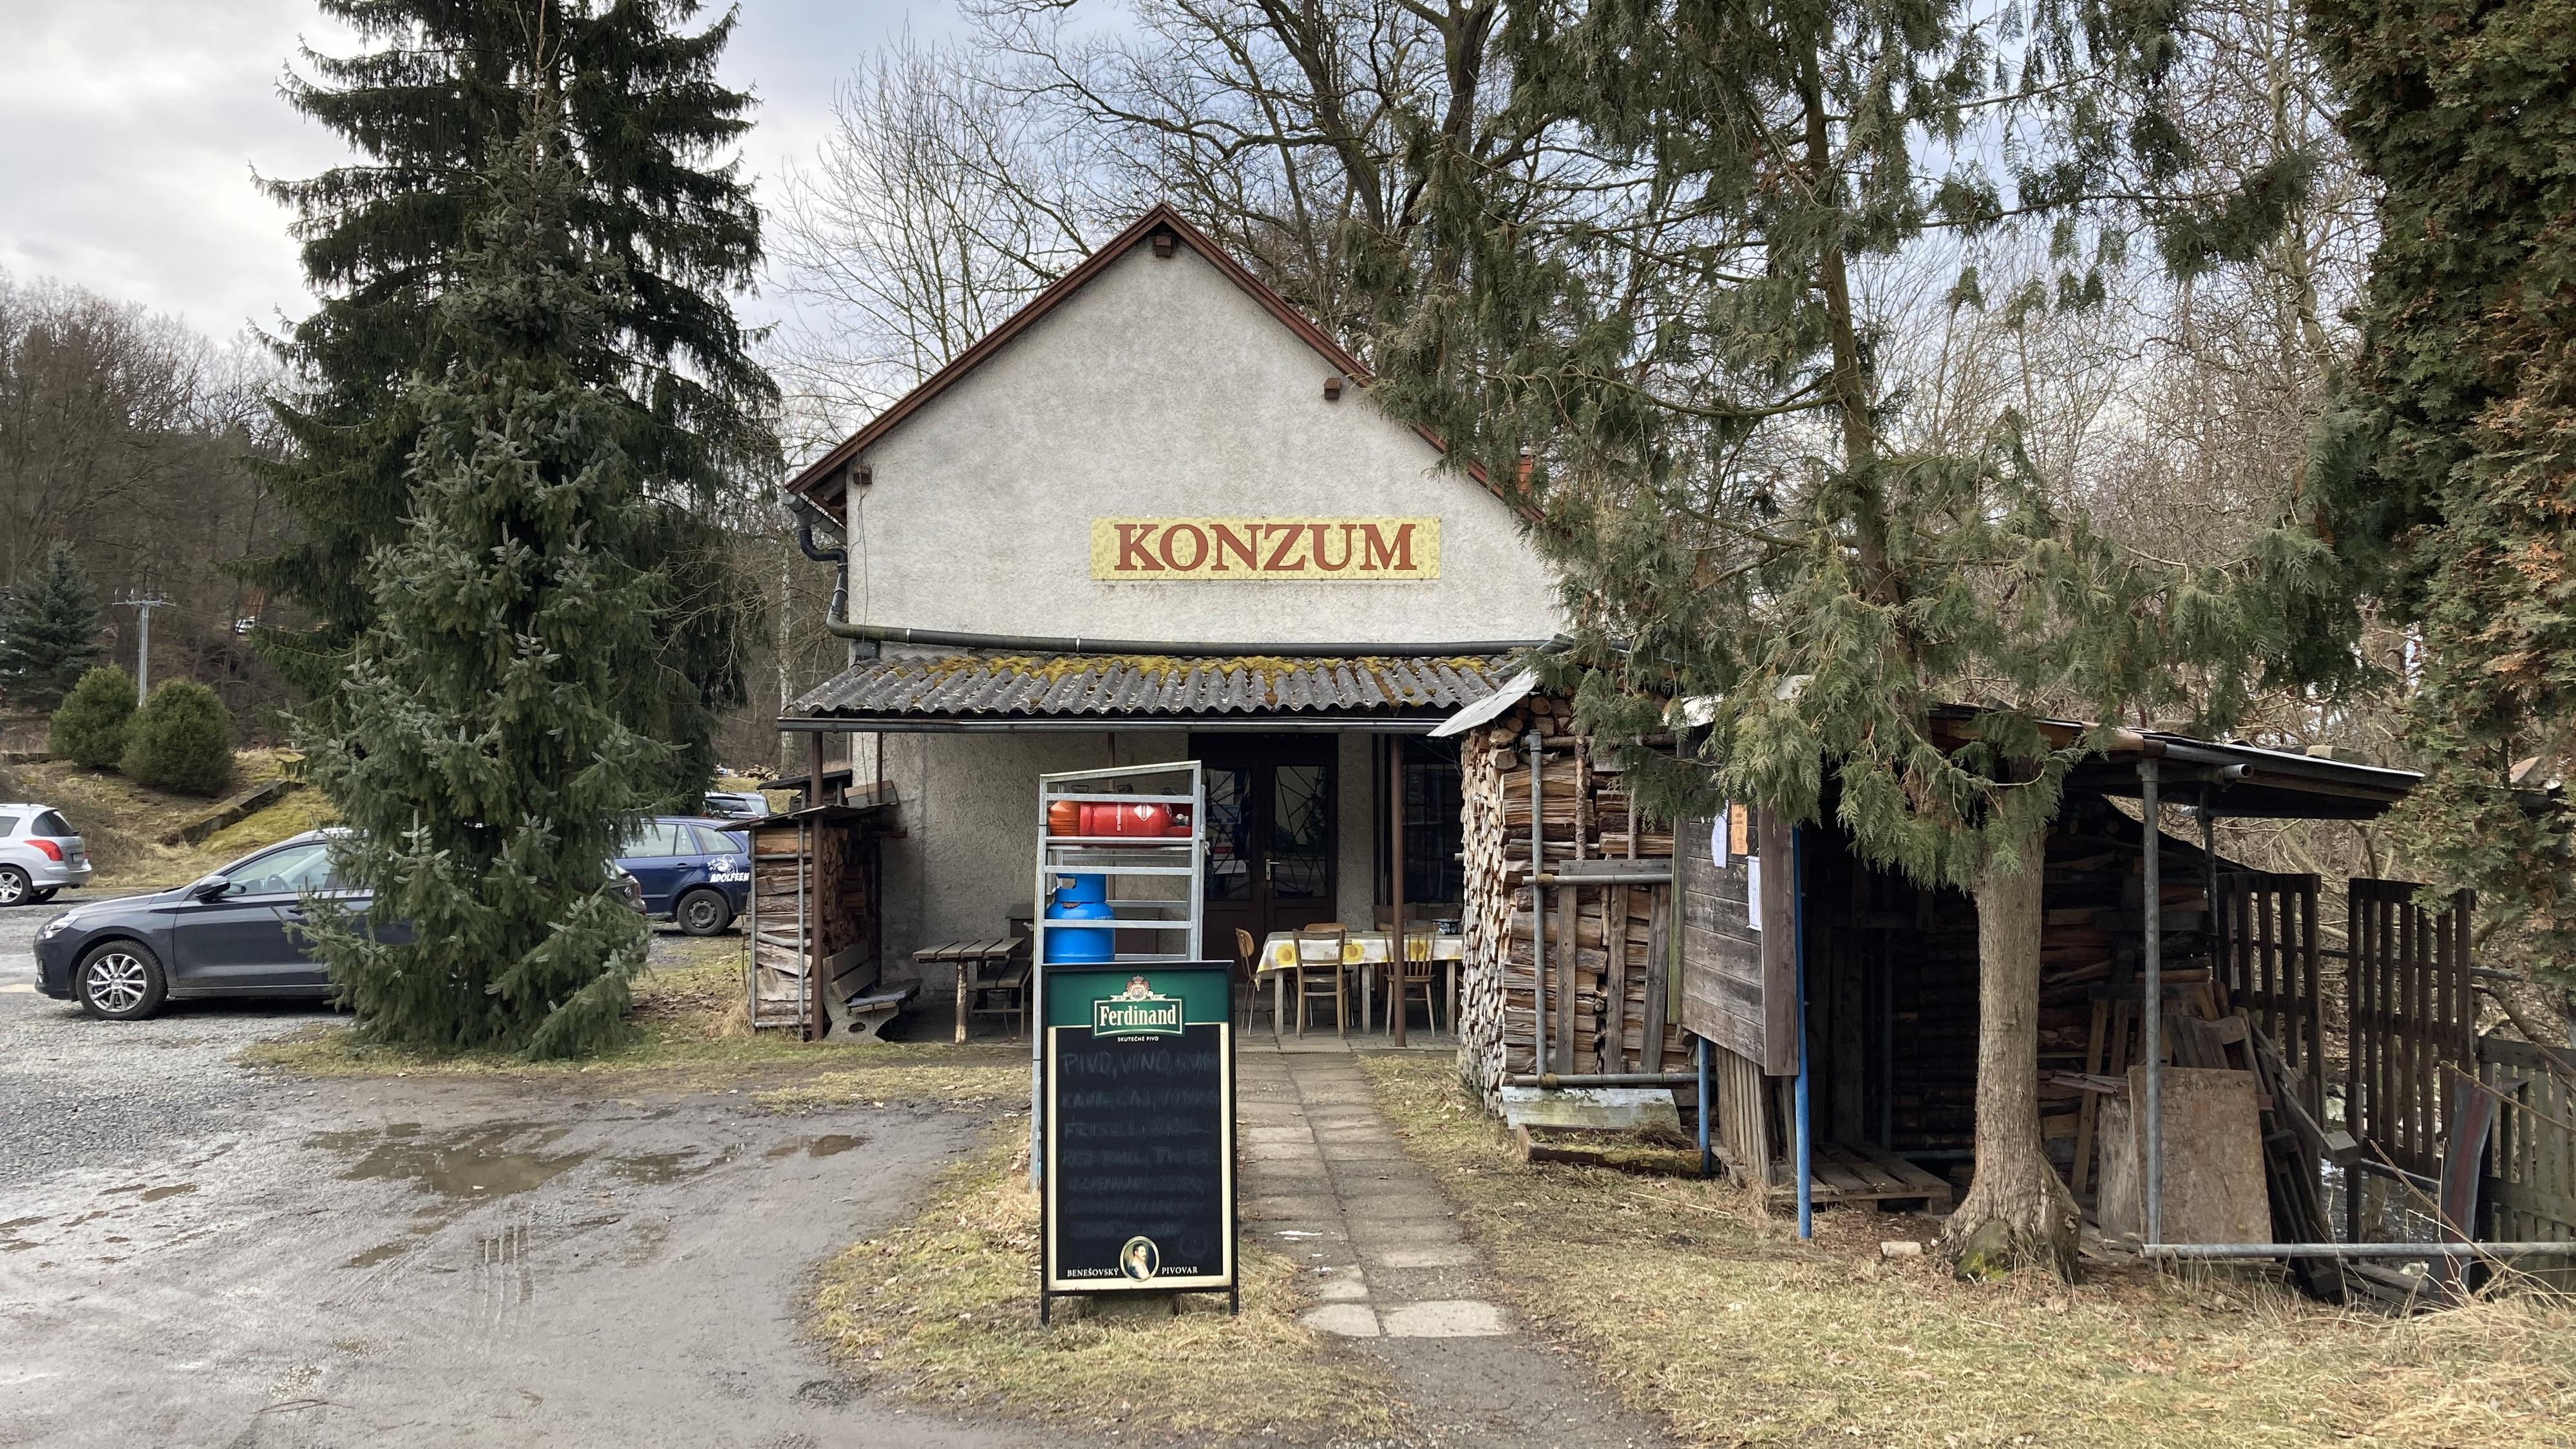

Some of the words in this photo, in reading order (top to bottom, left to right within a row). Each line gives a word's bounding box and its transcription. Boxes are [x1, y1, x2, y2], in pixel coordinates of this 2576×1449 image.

[1113, 523, 1417, 572] KONZUM
[1099, 1005, 1177, 1027] Ferdinand
[1066, 1267, 1119, 1278] BENEŠOVSKÝ
[1161, 1266, 1198, 1275] PIVOVAR
